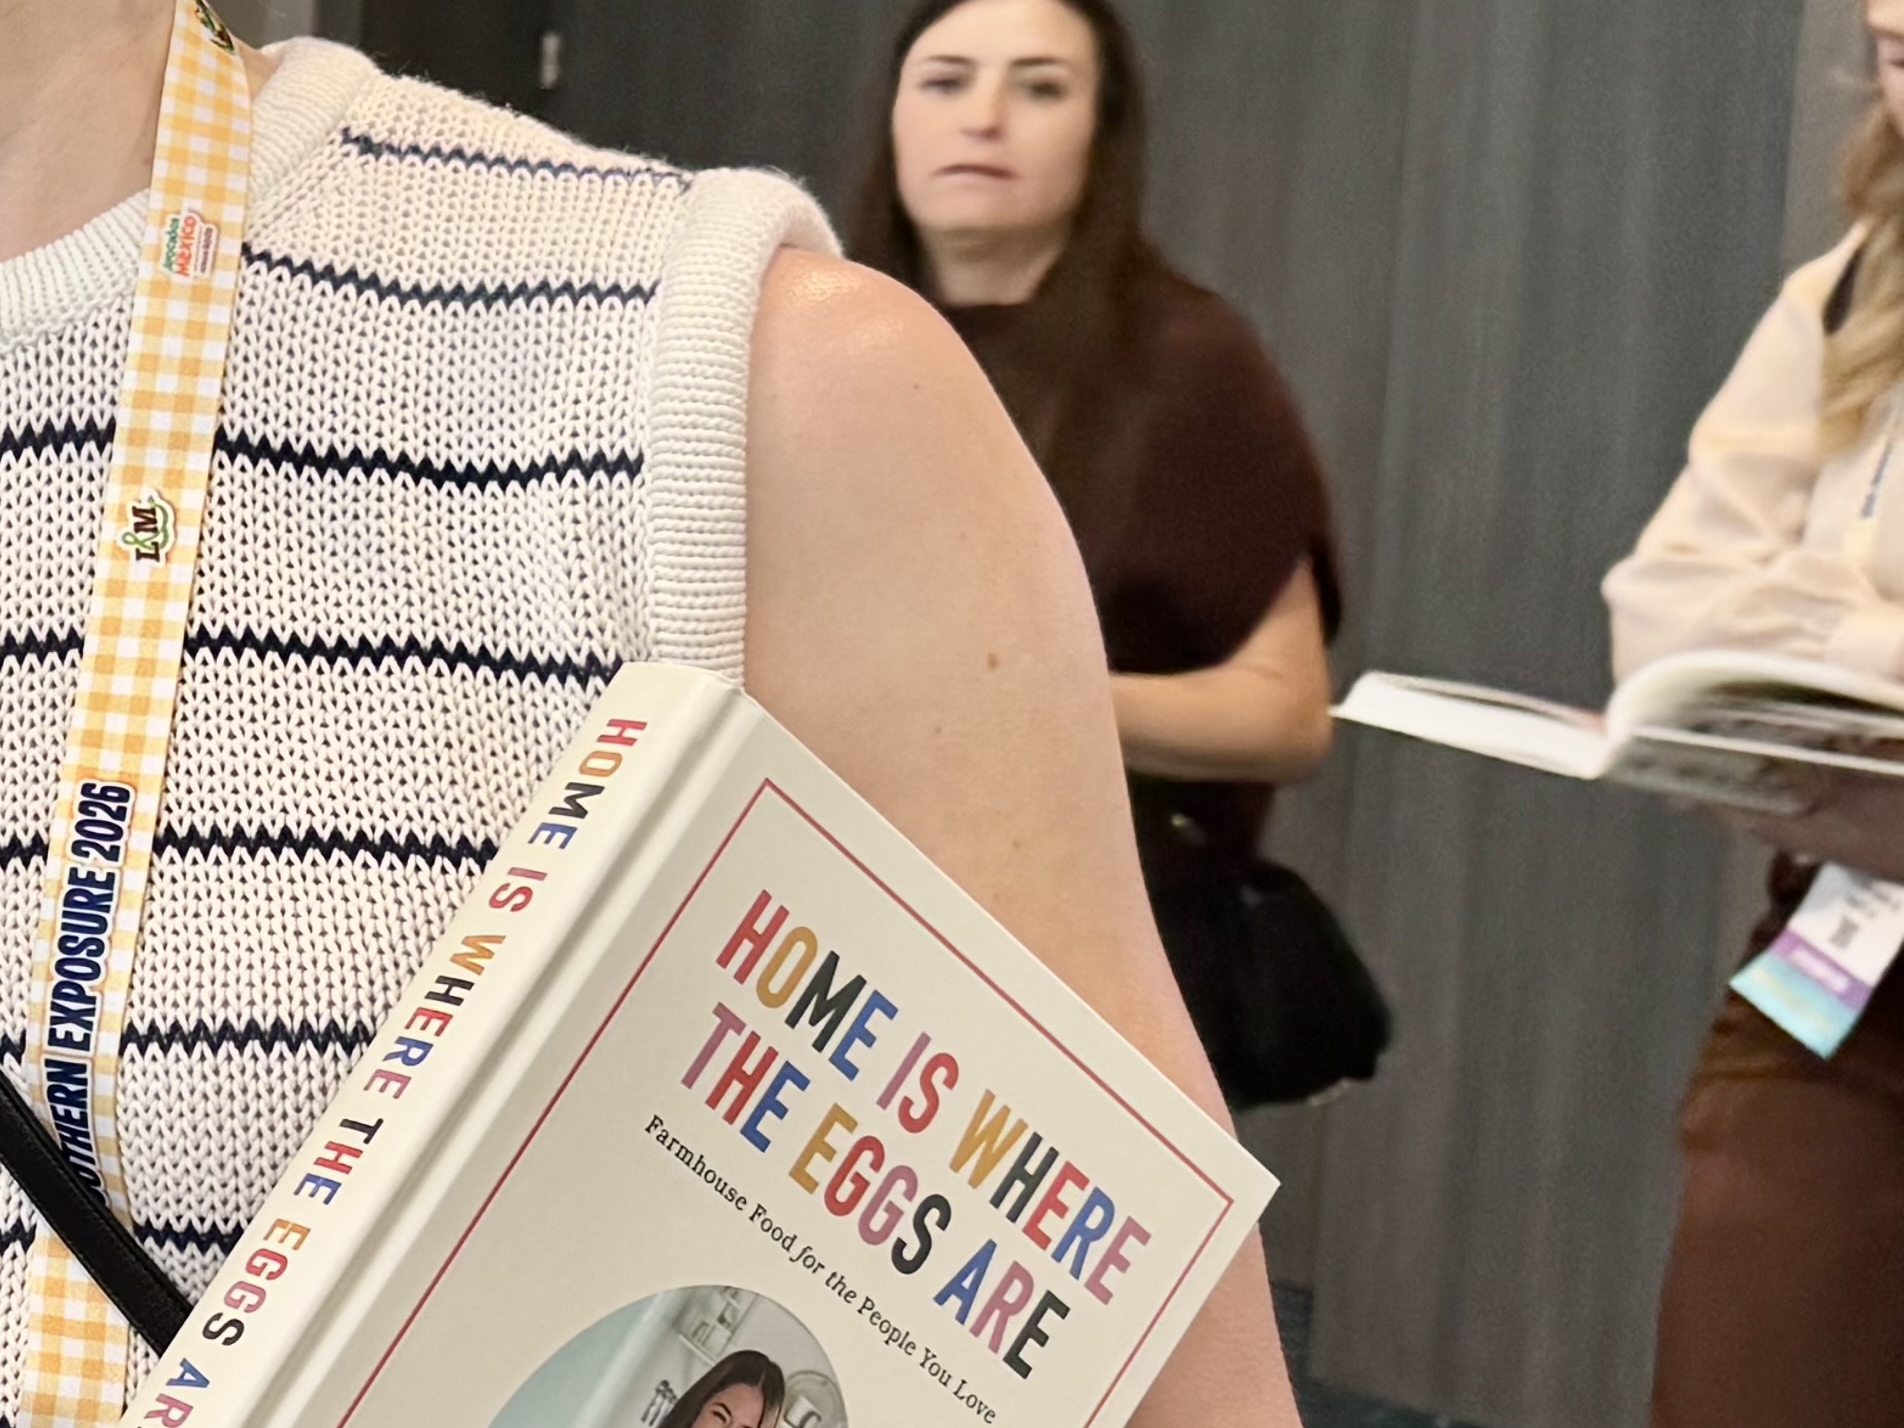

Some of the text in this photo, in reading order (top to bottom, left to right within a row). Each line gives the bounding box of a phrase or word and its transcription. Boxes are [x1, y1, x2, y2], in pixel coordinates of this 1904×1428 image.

[72, 783, 130, 863] 2026
[527, 717, 647, 850] HOME
[48, 868, 115, 1054] EXPOSURE
[487, 866, 548, 913] IS
[361, 933, 506, 1100] WHERE
[293, 1116, 383, 1205] THE
[716, 890, 1151, 1305] HOME IS WHERE
[681, 1002, 1070, 1380] THE EGGS ARE
[202, 1218, 311, 1346] EGGS
[645, 1115, 997, 1425] Farmhouse Food for the People You Love
